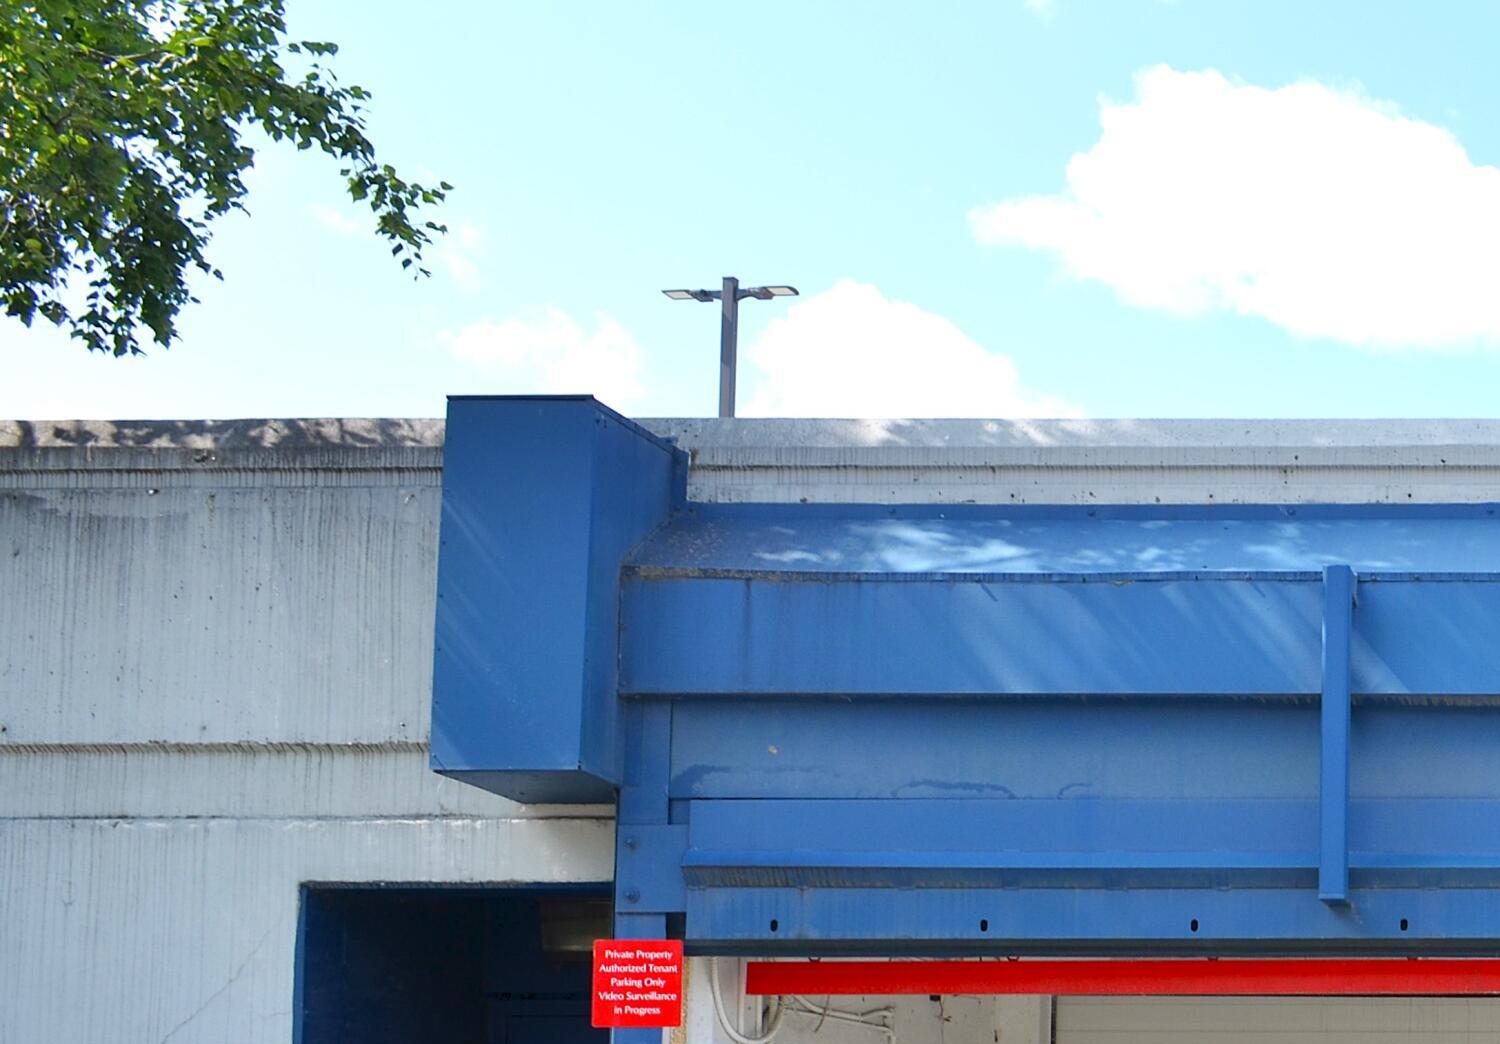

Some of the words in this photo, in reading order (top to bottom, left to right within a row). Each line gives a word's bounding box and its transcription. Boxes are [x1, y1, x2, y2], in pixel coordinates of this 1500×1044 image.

[605, 950, 634, 959] Private
[636, 950, 673, 960] Property
[599, 964, 646, 972] Authorized
[648, 964, 678, 973] Tenant
[610, 978, 642, 988] Parking
[644, 978, 666, 988] Only
[598, 991, 624, 1000] Video
[626, 991, 677, 1000] Surveillance
[614, 1005, 622, 1014] in
[624, 1005, 661, 1016] Progress
